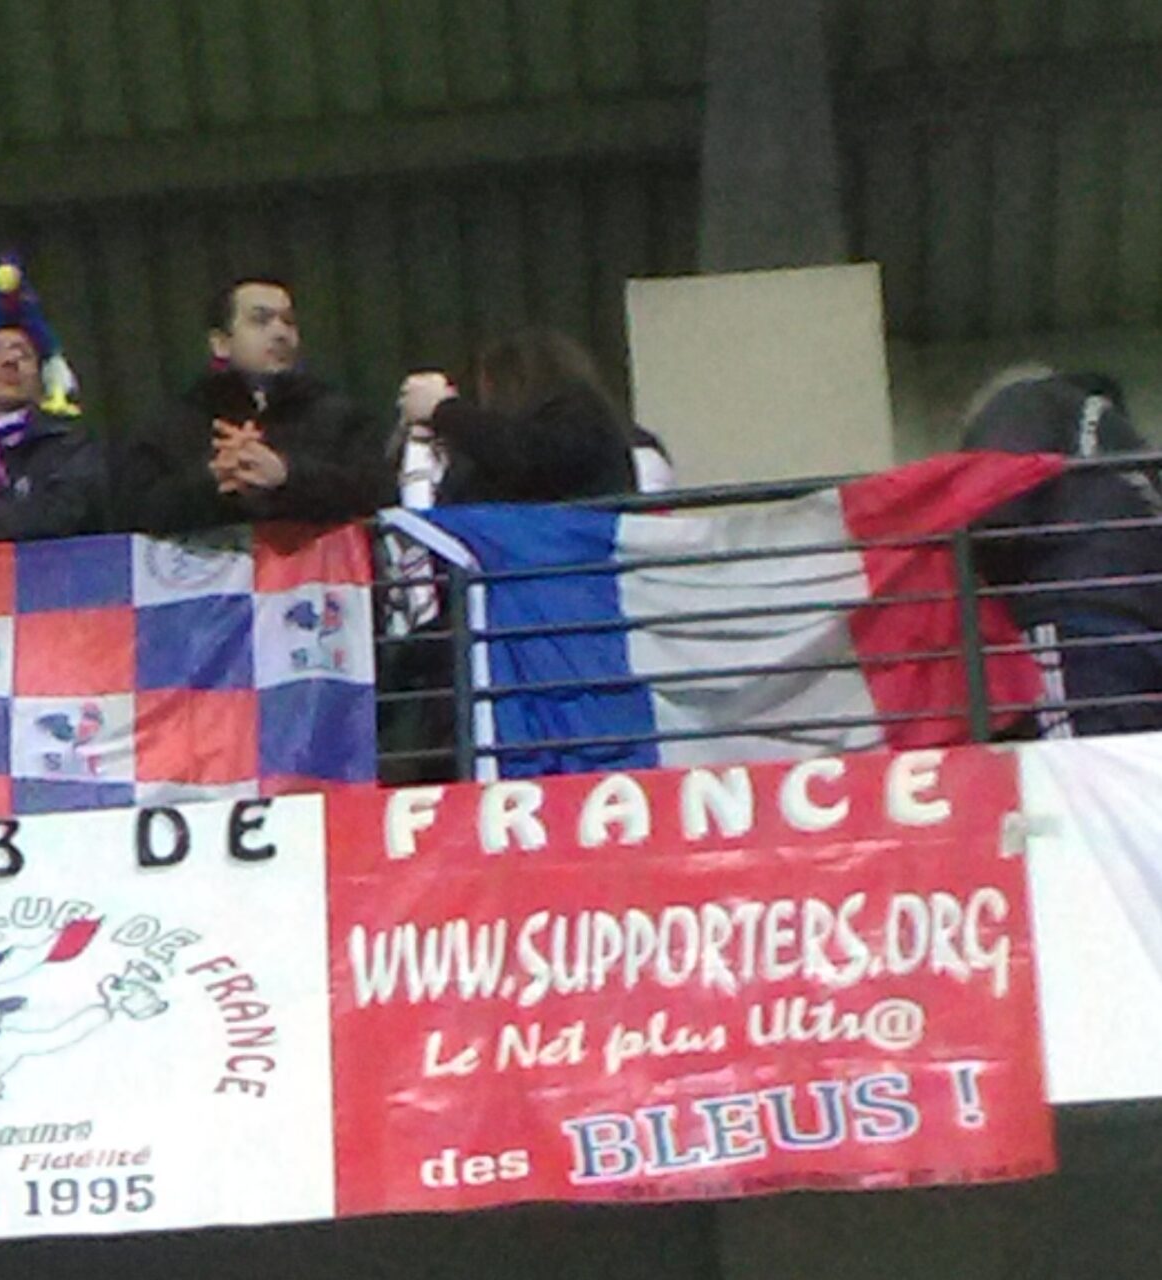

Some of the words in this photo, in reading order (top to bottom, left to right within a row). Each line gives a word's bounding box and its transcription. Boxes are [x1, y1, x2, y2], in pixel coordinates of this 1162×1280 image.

[136, 798, 277, 868] DE
[384, 750, 952, 860] FRANCE
[110, 913, 203, 967] DE
[184, 955, 280, 1098] FRANCE
[348, 886, 1011, 1008] WWW.SUPPORTERS.ORG
[424, 1030, 484, 1077] Le
[496, 1020, 586, 1072] Net
[604, 1009, 727, 1076] plus
[748, 996, 925, 1051] Ultr@
[420, 1148, 530, 1188] des
[561, 1072, 921, 1185] BLEUS
[953, 1062, 985, 1129] !
[24, 1174, 157, 1217] 1995
